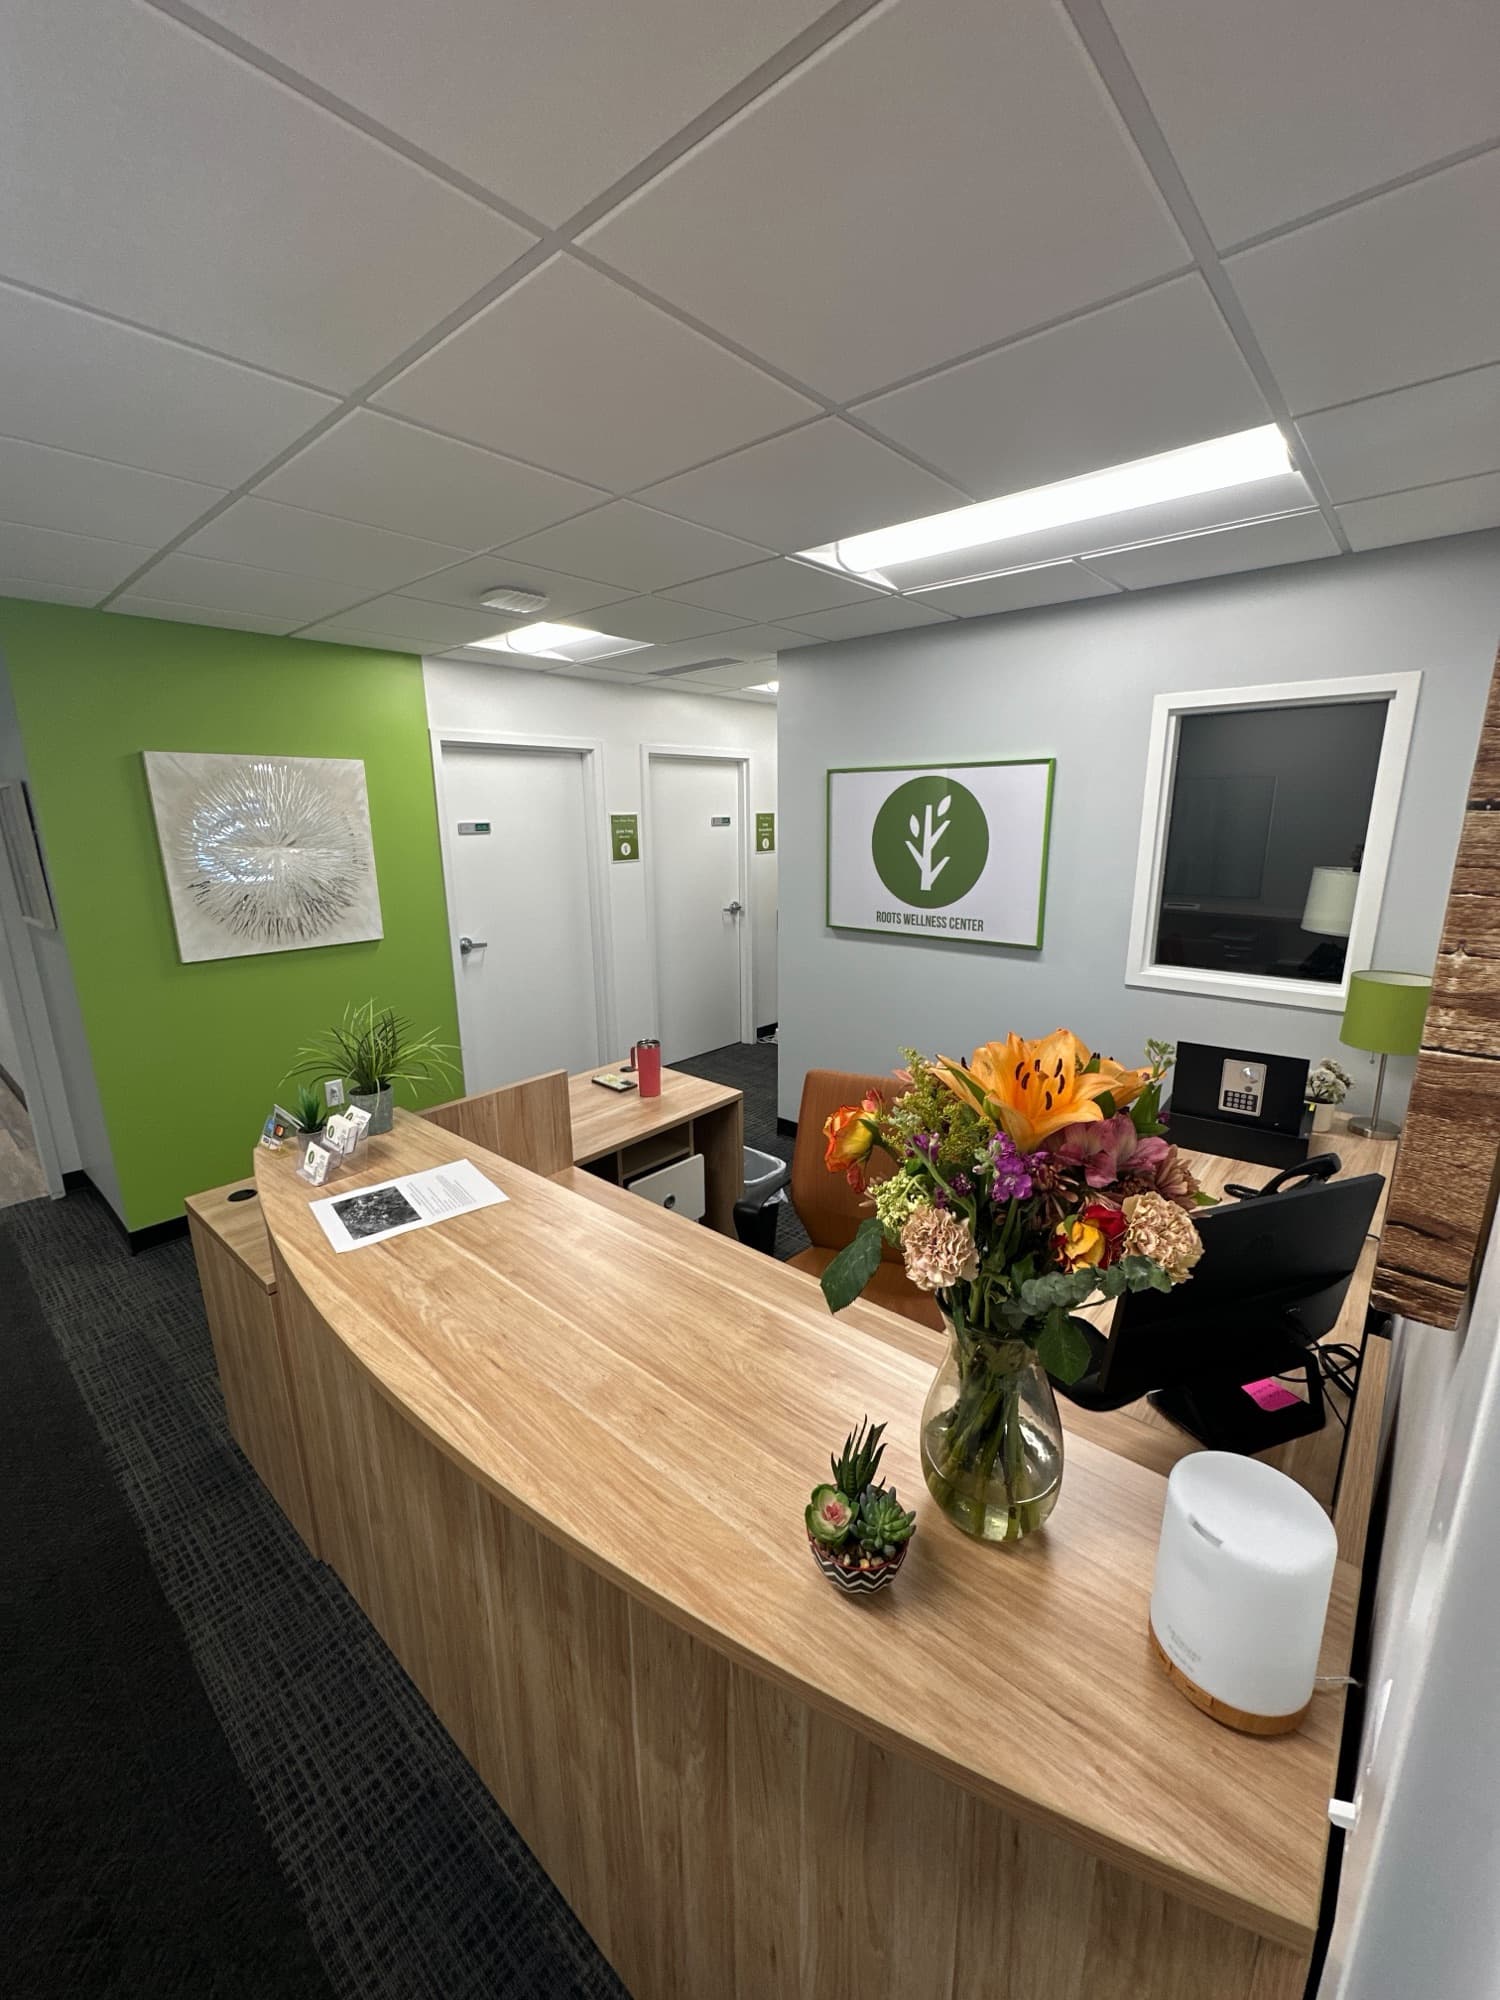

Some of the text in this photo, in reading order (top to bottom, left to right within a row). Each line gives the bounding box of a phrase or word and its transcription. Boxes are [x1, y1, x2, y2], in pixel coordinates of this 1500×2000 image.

[876, 911, 984, 932] ROOTS WELLNESS CENTER
